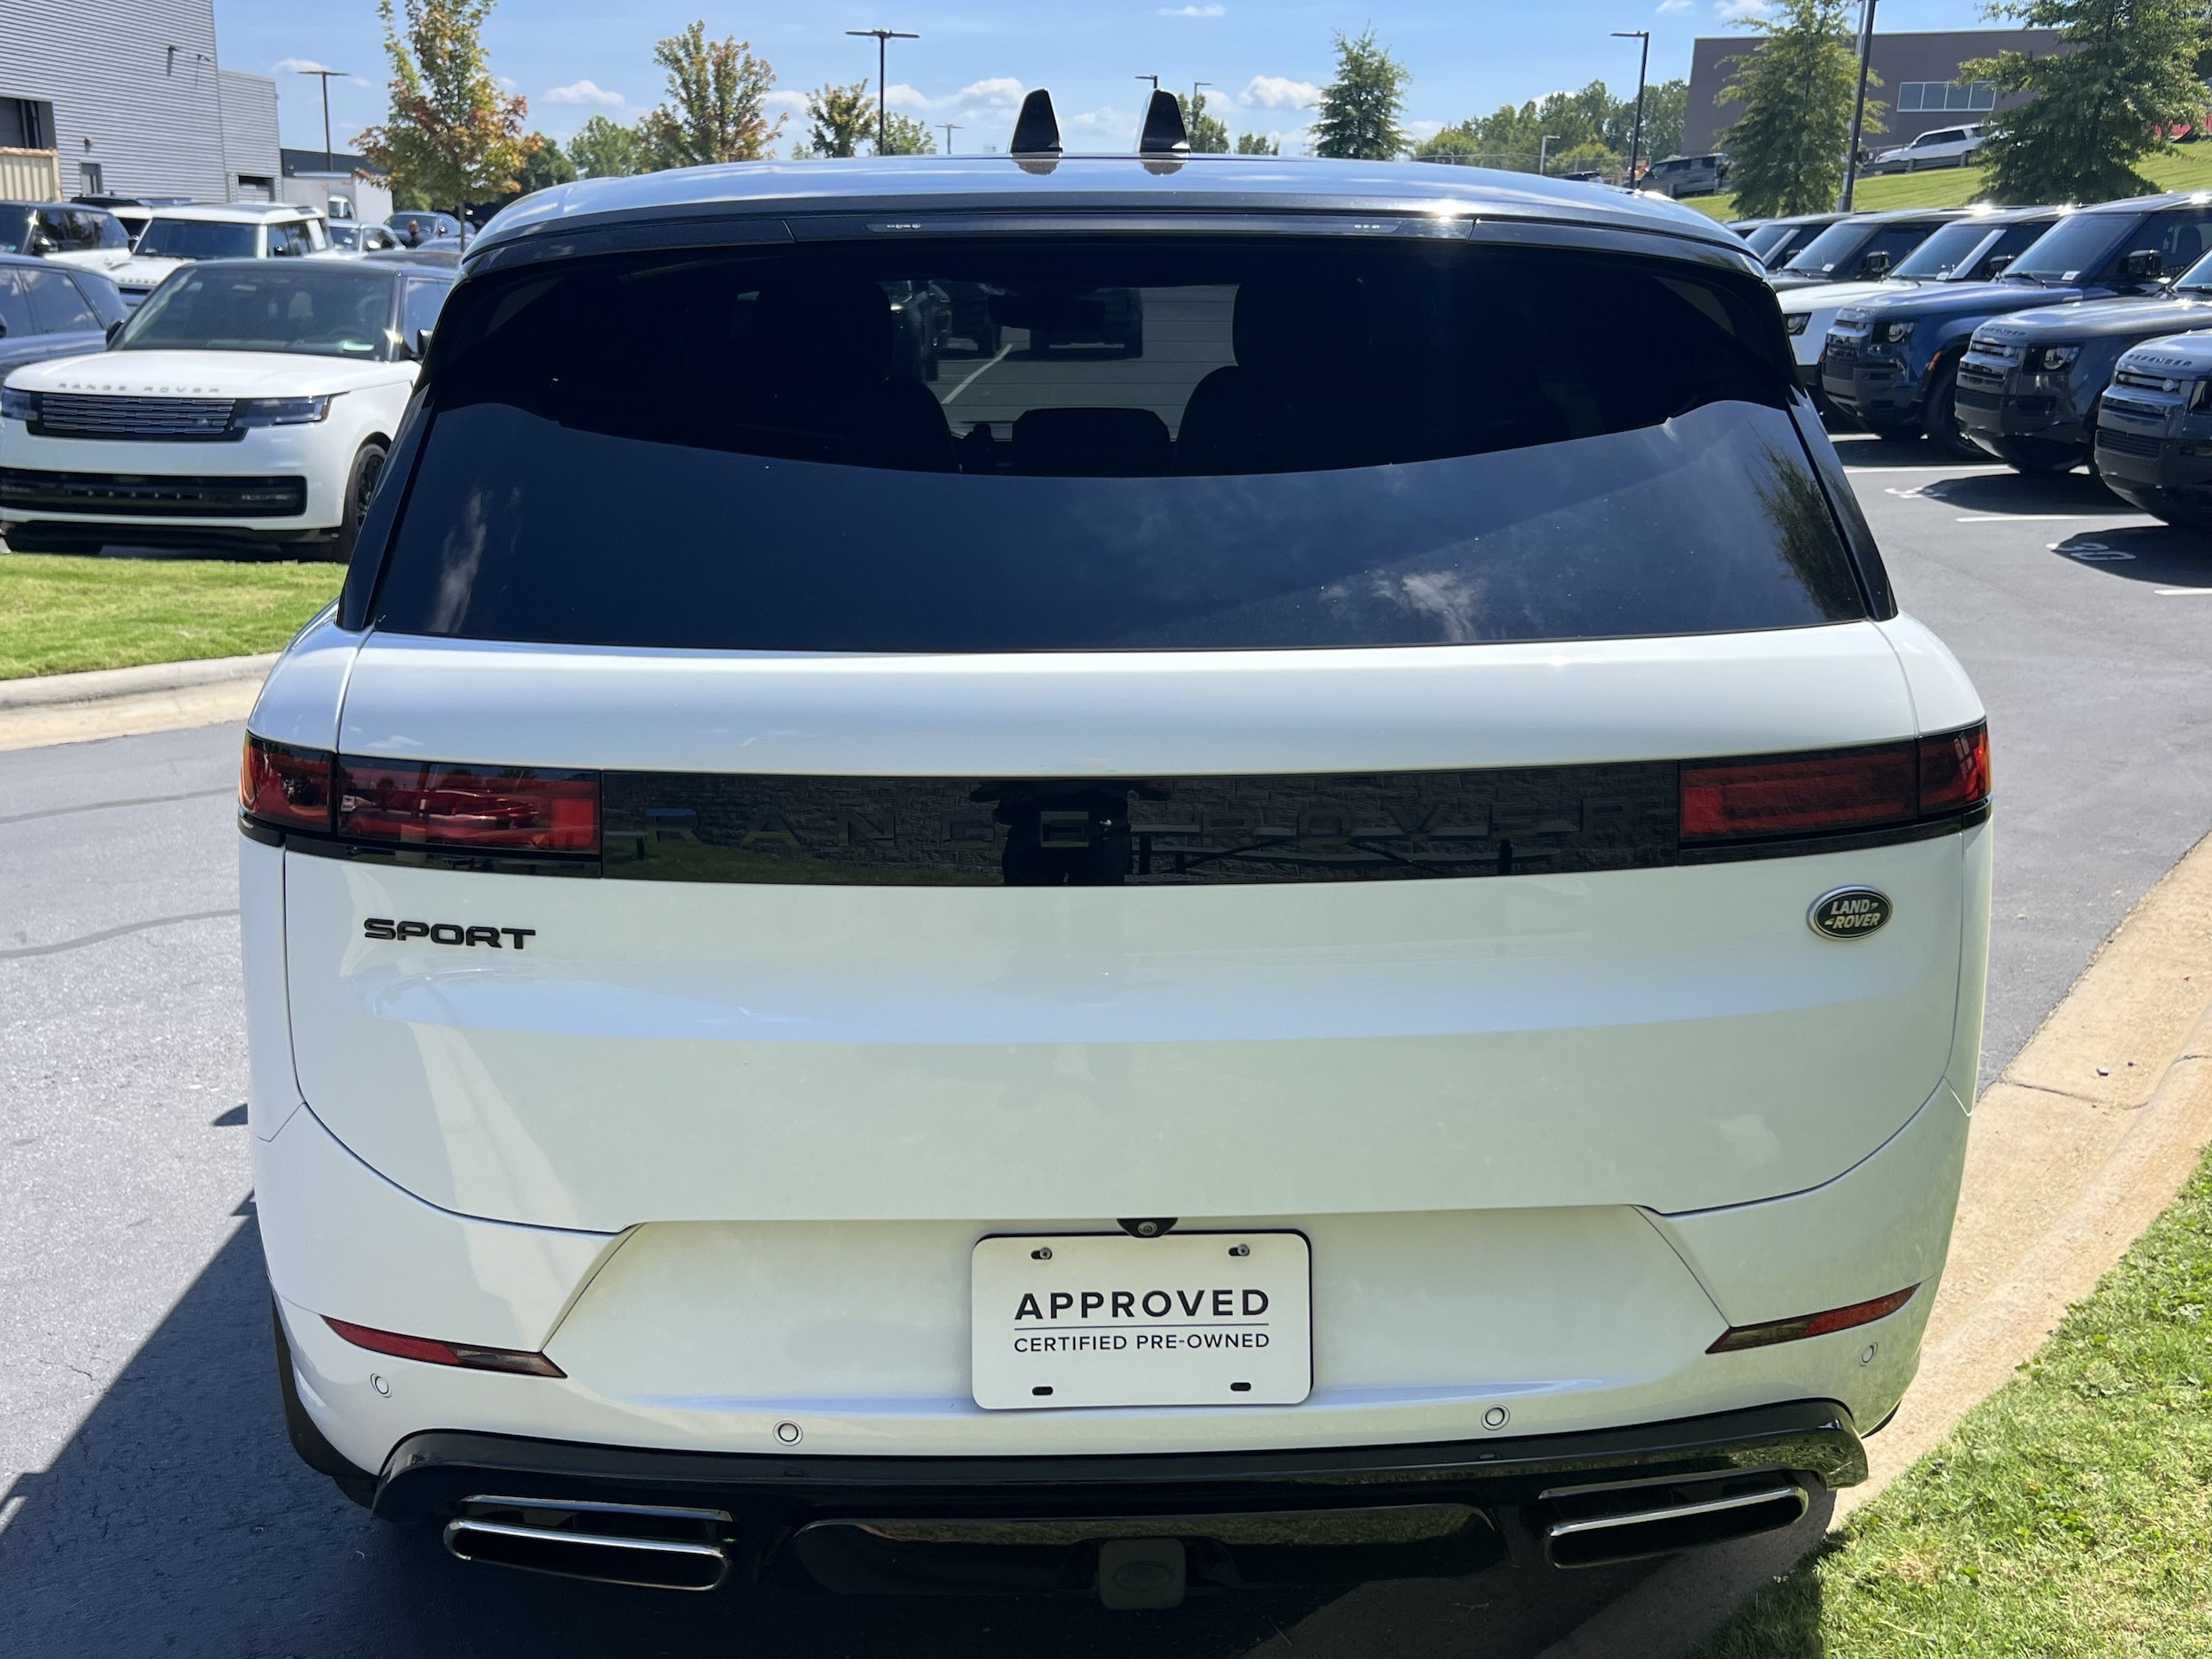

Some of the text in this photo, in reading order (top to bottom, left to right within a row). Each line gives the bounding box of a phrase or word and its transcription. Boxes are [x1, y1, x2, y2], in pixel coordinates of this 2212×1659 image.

[58, 382, 127, 391] RANGE
[645, 797, 1640, 848] RANGE ROVER
[1830, 898, 1871, 915] LAND
[1832, 912, 1881, 929] ROVER
[364, 918, 536, 949] SPORT
[1014, 1288, 1269, 1320] APPROVED
[1013, 1333, 1270, 1353] CERTIFIED PRE-OWNED
